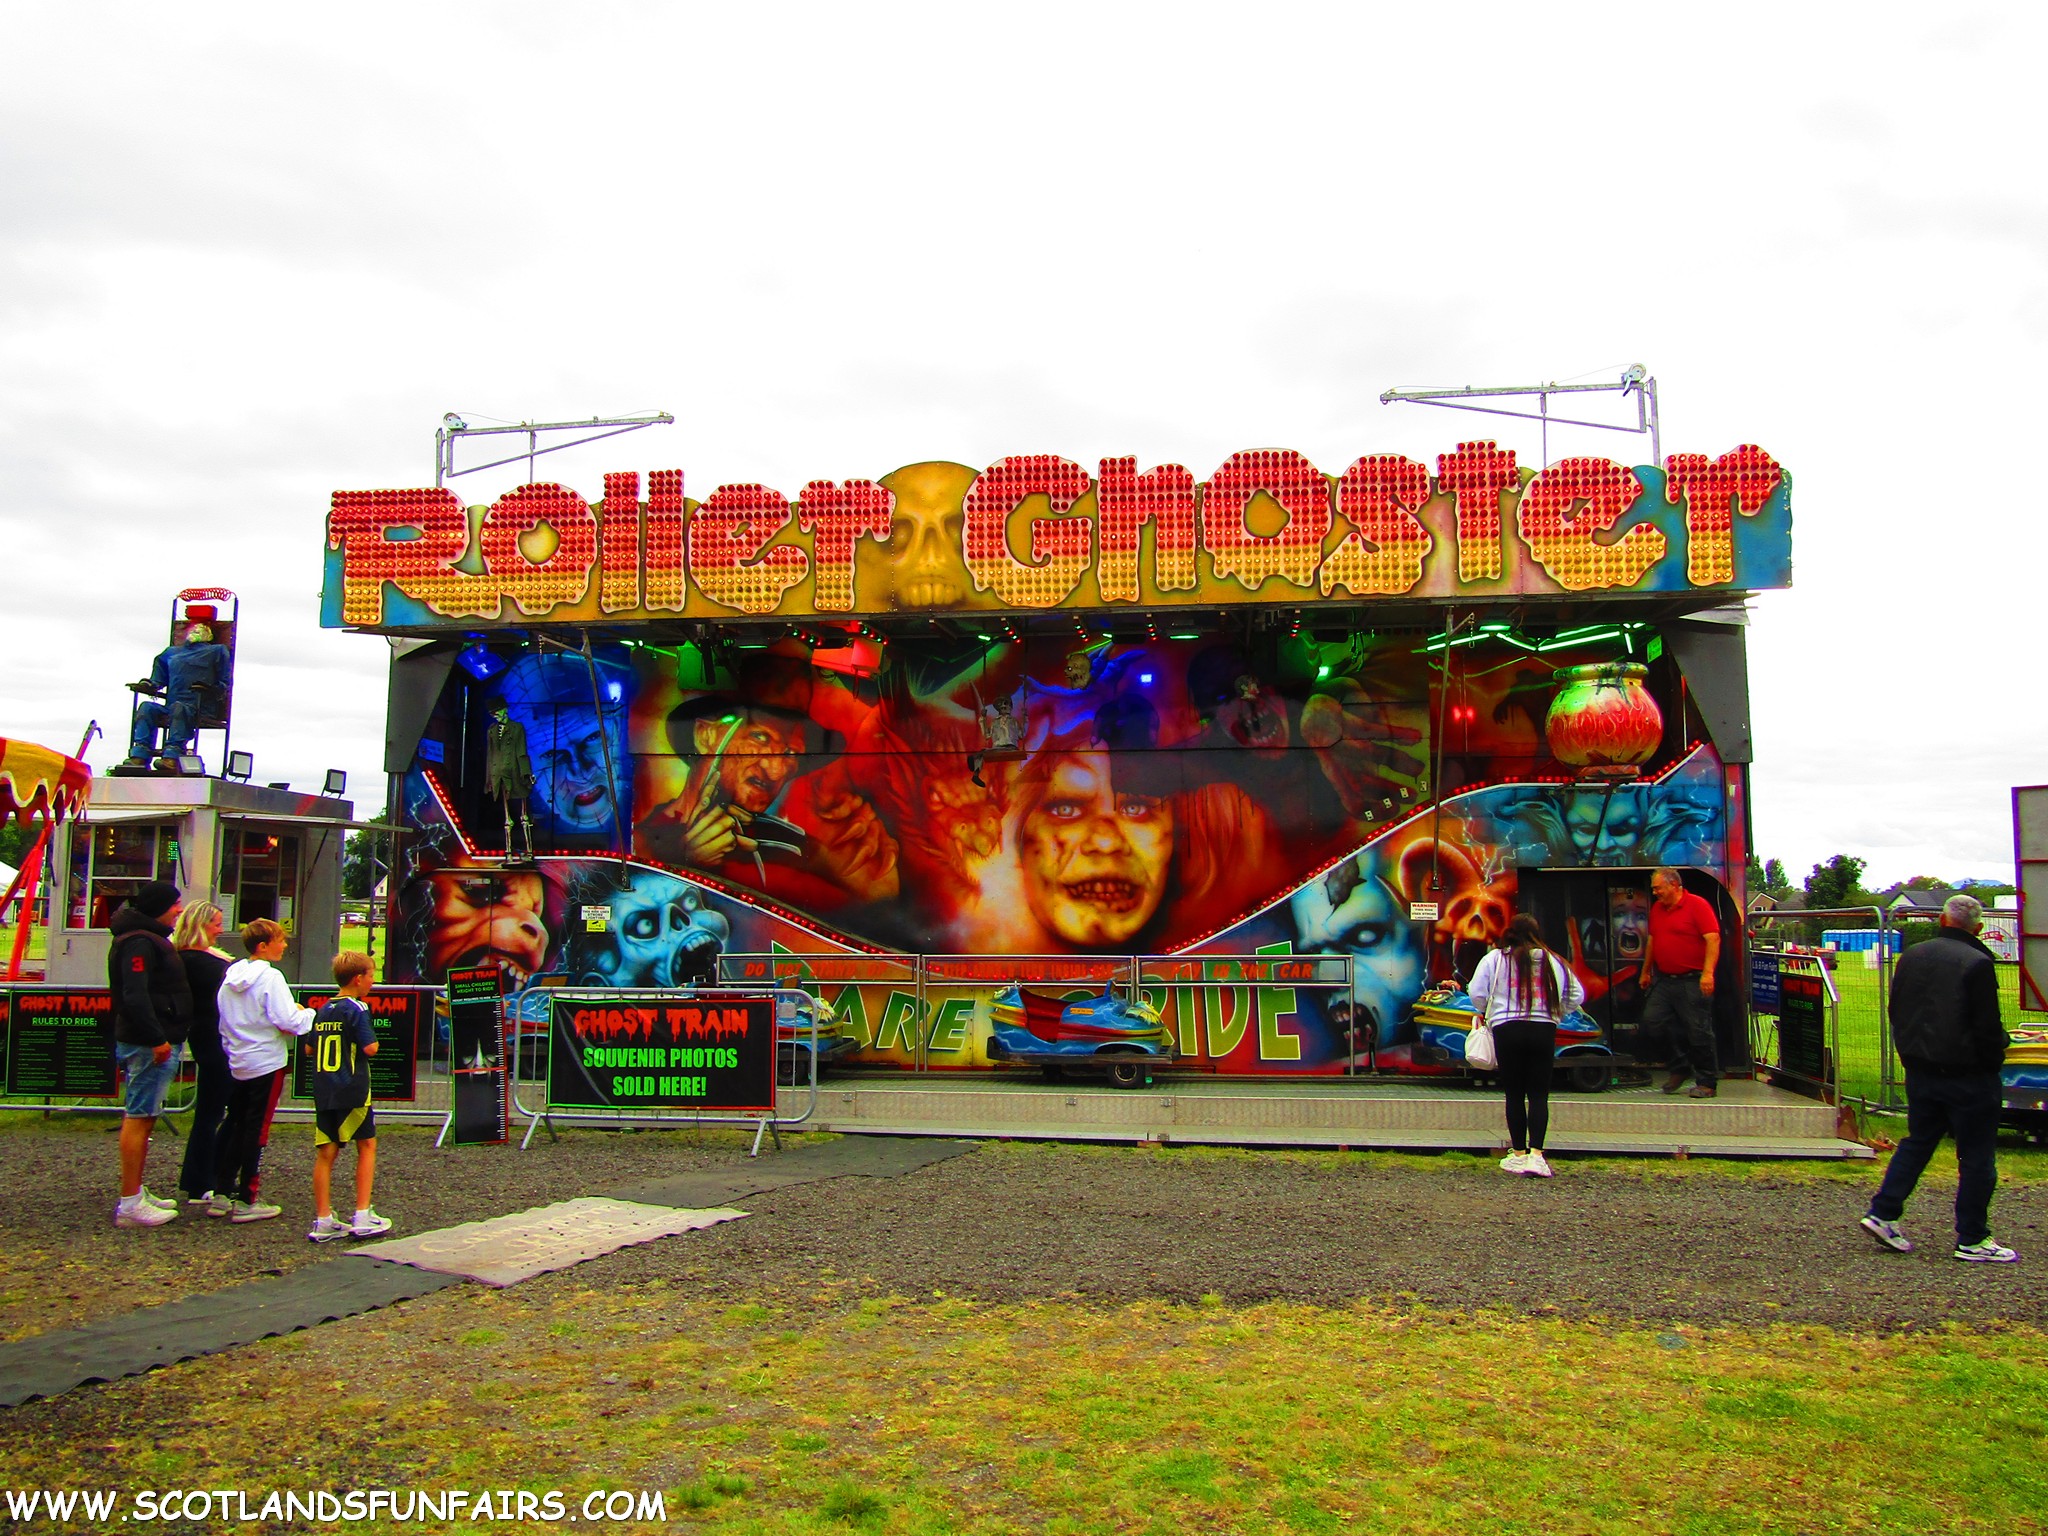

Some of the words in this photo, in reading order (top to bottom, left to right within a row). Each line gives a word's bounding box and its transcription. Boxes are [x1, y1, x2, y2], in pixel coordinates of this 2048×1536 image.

[132, 956, 144, 972] 3
[744, 963, 766, 977] DO
[775, 963, 803, 976] NOT
[810, 963, 858, 977] STAND
[1170, 964, 1202, 979] PAY
[1212, 964, 1231, 978] IN
[1240, 964, 1269, 978] THE
[1279, 963, 1313, 979] CAR
[20, 996, 65, 1014] GHOST
[68, 996, 112, 1014] TRAIN
[32, 1017, 59, 1025] RULES
[61, 1017, 73, 1025] TO
[74, 1017, 98, 1026] RIDE:
[373, 1018, 392, 1028] IDE:
[573, 1008, 659, 1043] GHOST
[665, 1008, 748, 1043] TRAIN
[316, 1034, 342, 1073] 10
[583, 1047, 666, 1069] SOUVENIR
[670, 1047, 738, 1069] PHOTOS
[612, 1076, 655, 1097] SOLD
[659, 1076, 707, 1096] HERE!
